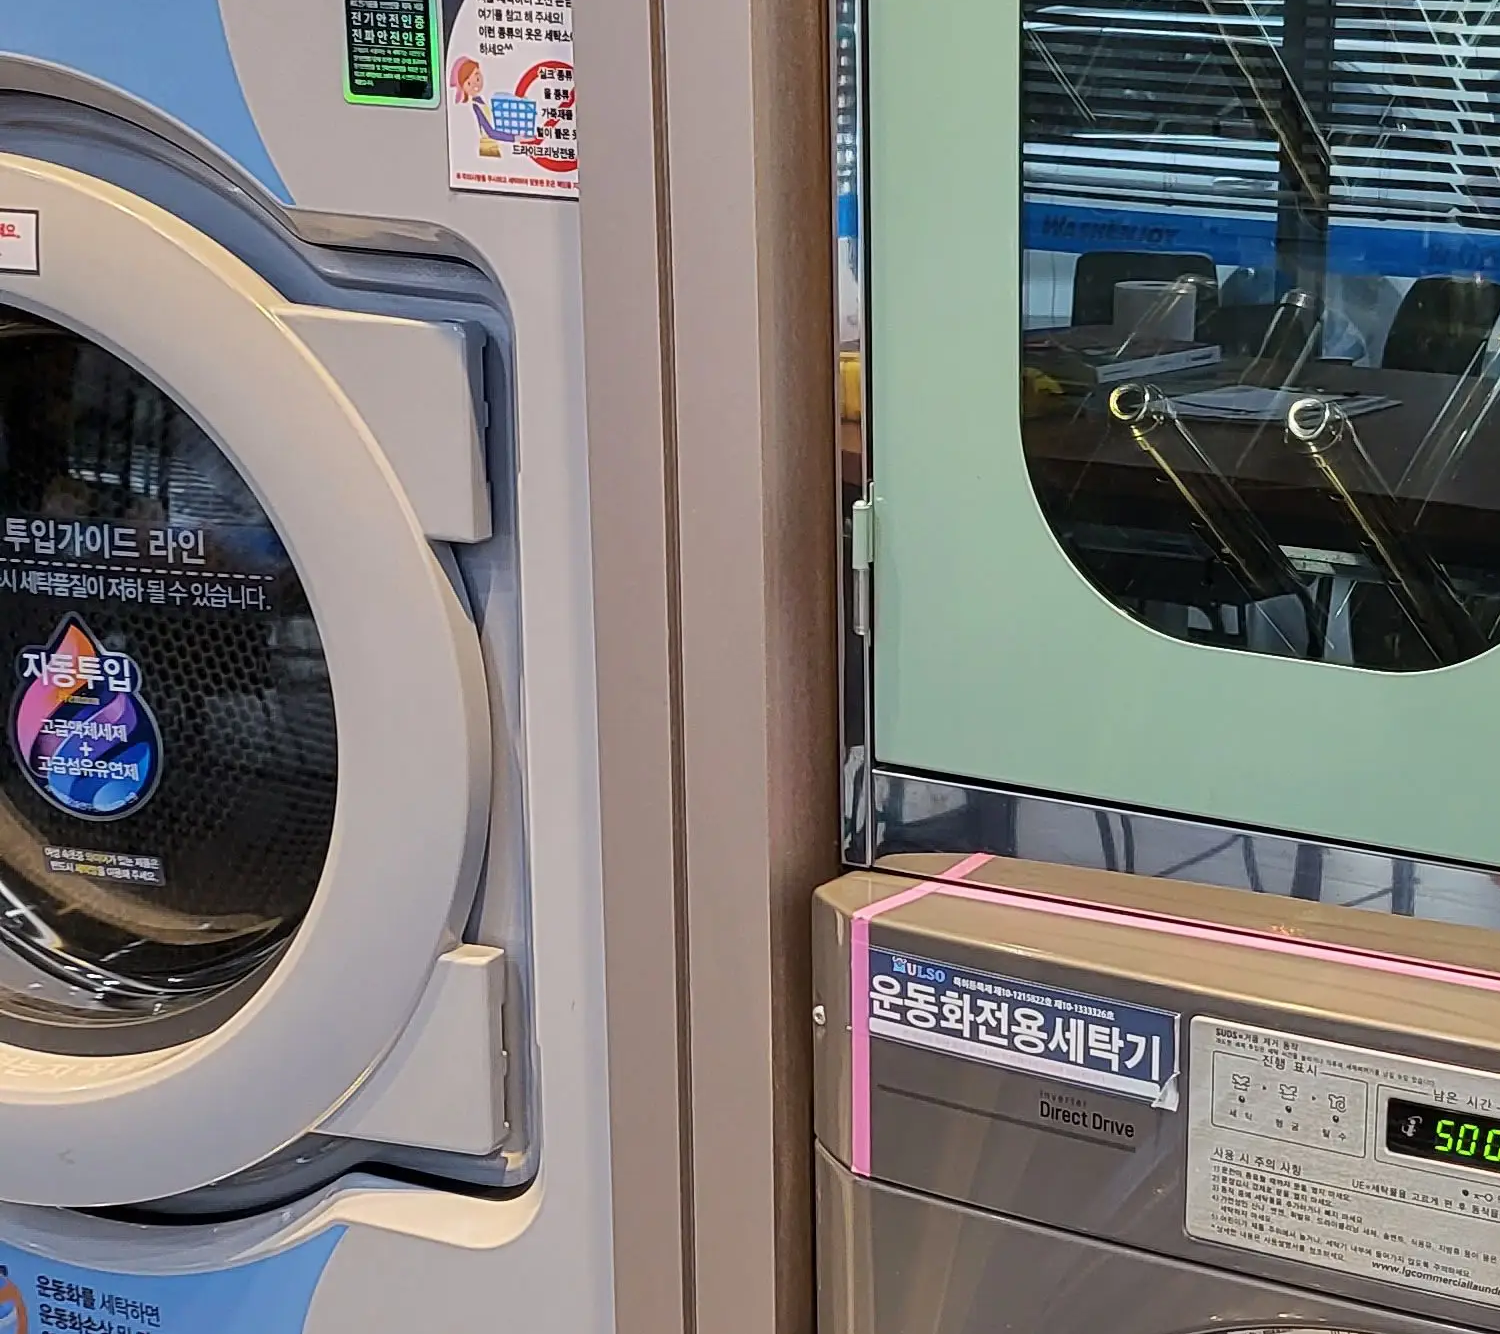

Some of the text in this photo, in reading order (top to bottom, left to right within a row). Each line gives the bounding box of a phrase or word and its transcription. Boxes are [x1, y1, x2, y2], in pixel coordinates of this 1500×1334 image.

[3, 517, 206, 564] 투입가이드 라인
[23, 652, 131, 693] 자동투입
[38, 755, 139, 781] 고급섬유유연제
[870, 974, 1160, 1081] 운동화전용세탁기
[1040, 1101, 1135, 1139] Direct Drive
[1433, 1089, 1492, 1111] 남은 시간
[36, 1275, 160, 1327] 운동화를 세탁하면
